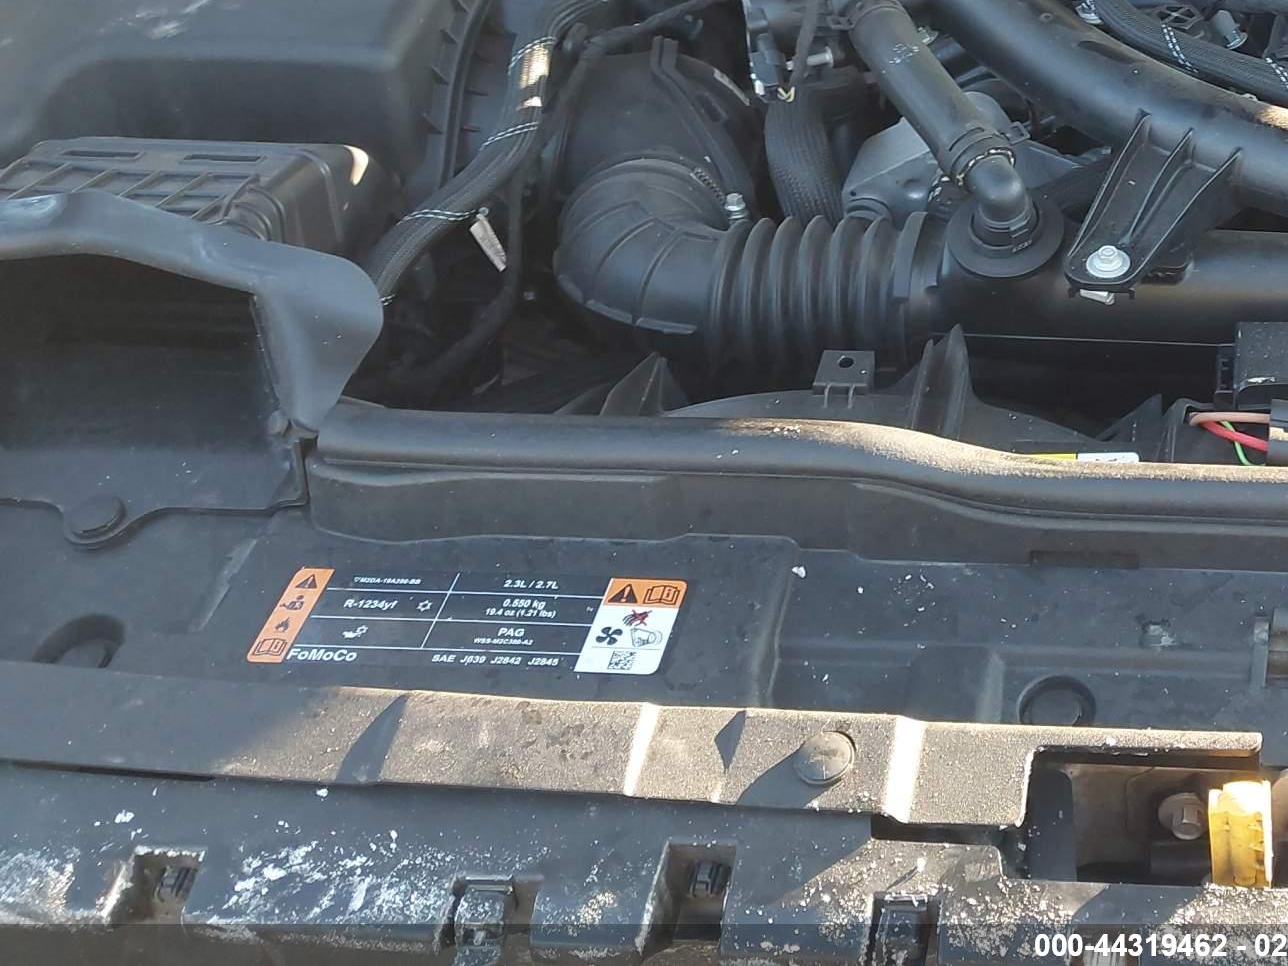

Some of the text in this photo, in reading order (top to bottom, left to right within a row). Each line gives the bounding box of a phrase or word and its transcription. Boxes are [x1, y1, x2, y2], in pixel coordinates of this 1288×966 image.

[503, 579, 526, 589] 2.3L
[535, 581, 559, 590] 2.7L
[343, 598, 399, 611] R-1234yf
[532, 599, 546, 610] kg
[485, 607, 502, 616] 19.4
[497, 627, 525, 637] PAG
[286, 648, 357, 662] FoMoCo
[431, 654, 457, 663] SAE
